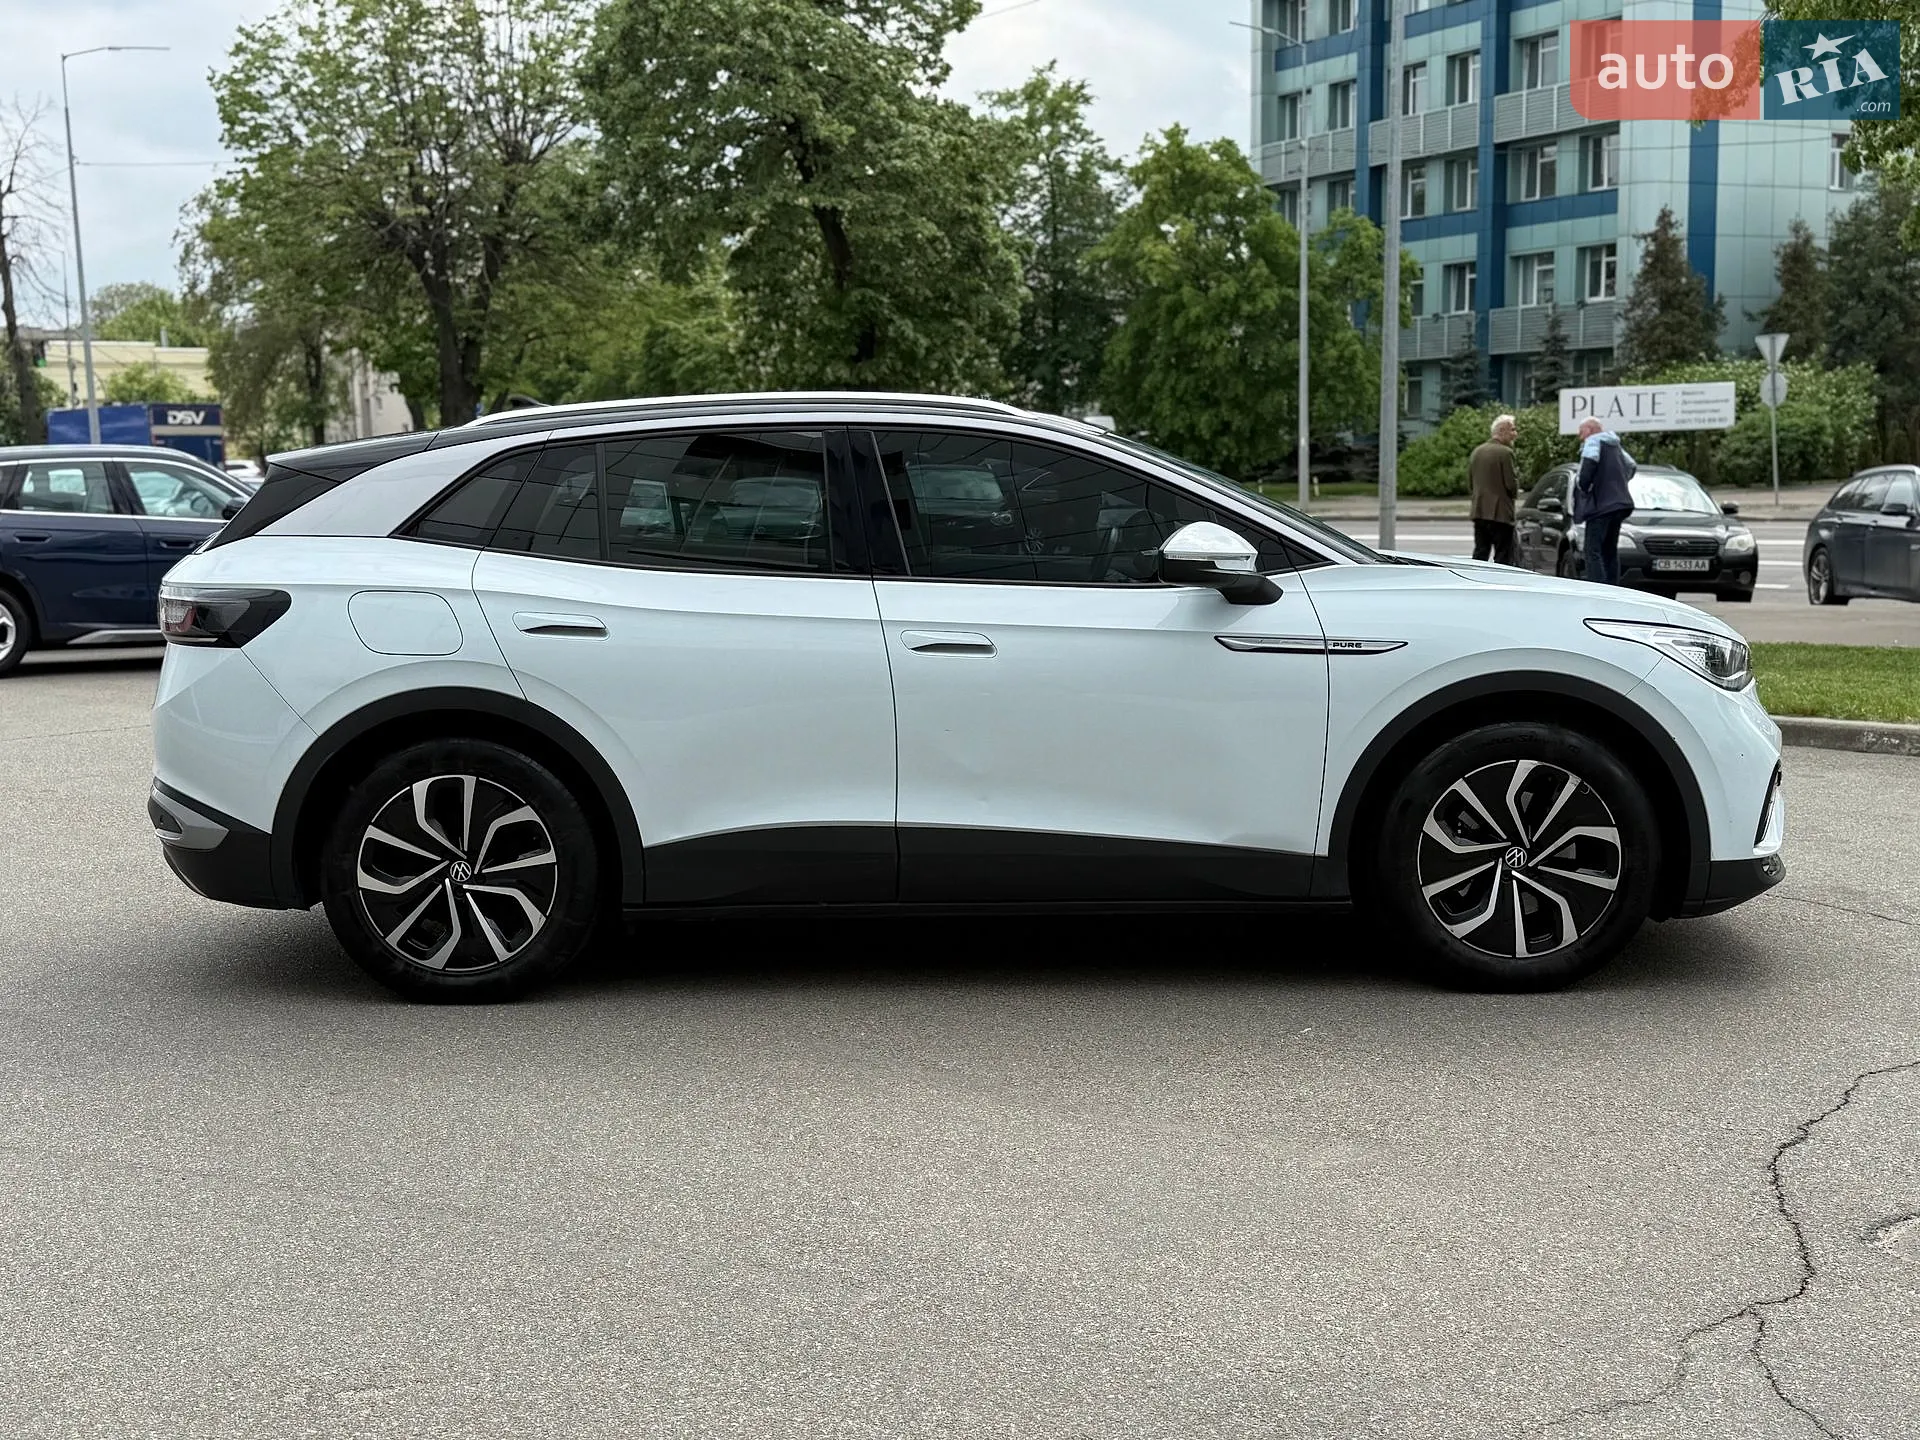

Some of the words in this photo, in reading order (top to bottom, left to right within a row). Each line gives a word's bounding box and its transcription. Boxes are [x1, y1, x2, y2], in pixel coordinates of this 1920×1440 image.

[1571, 392, 1667, 419] PLATE
[167, 410, 205, 424] DSV
[1695, 560, 1706, 569] AA
